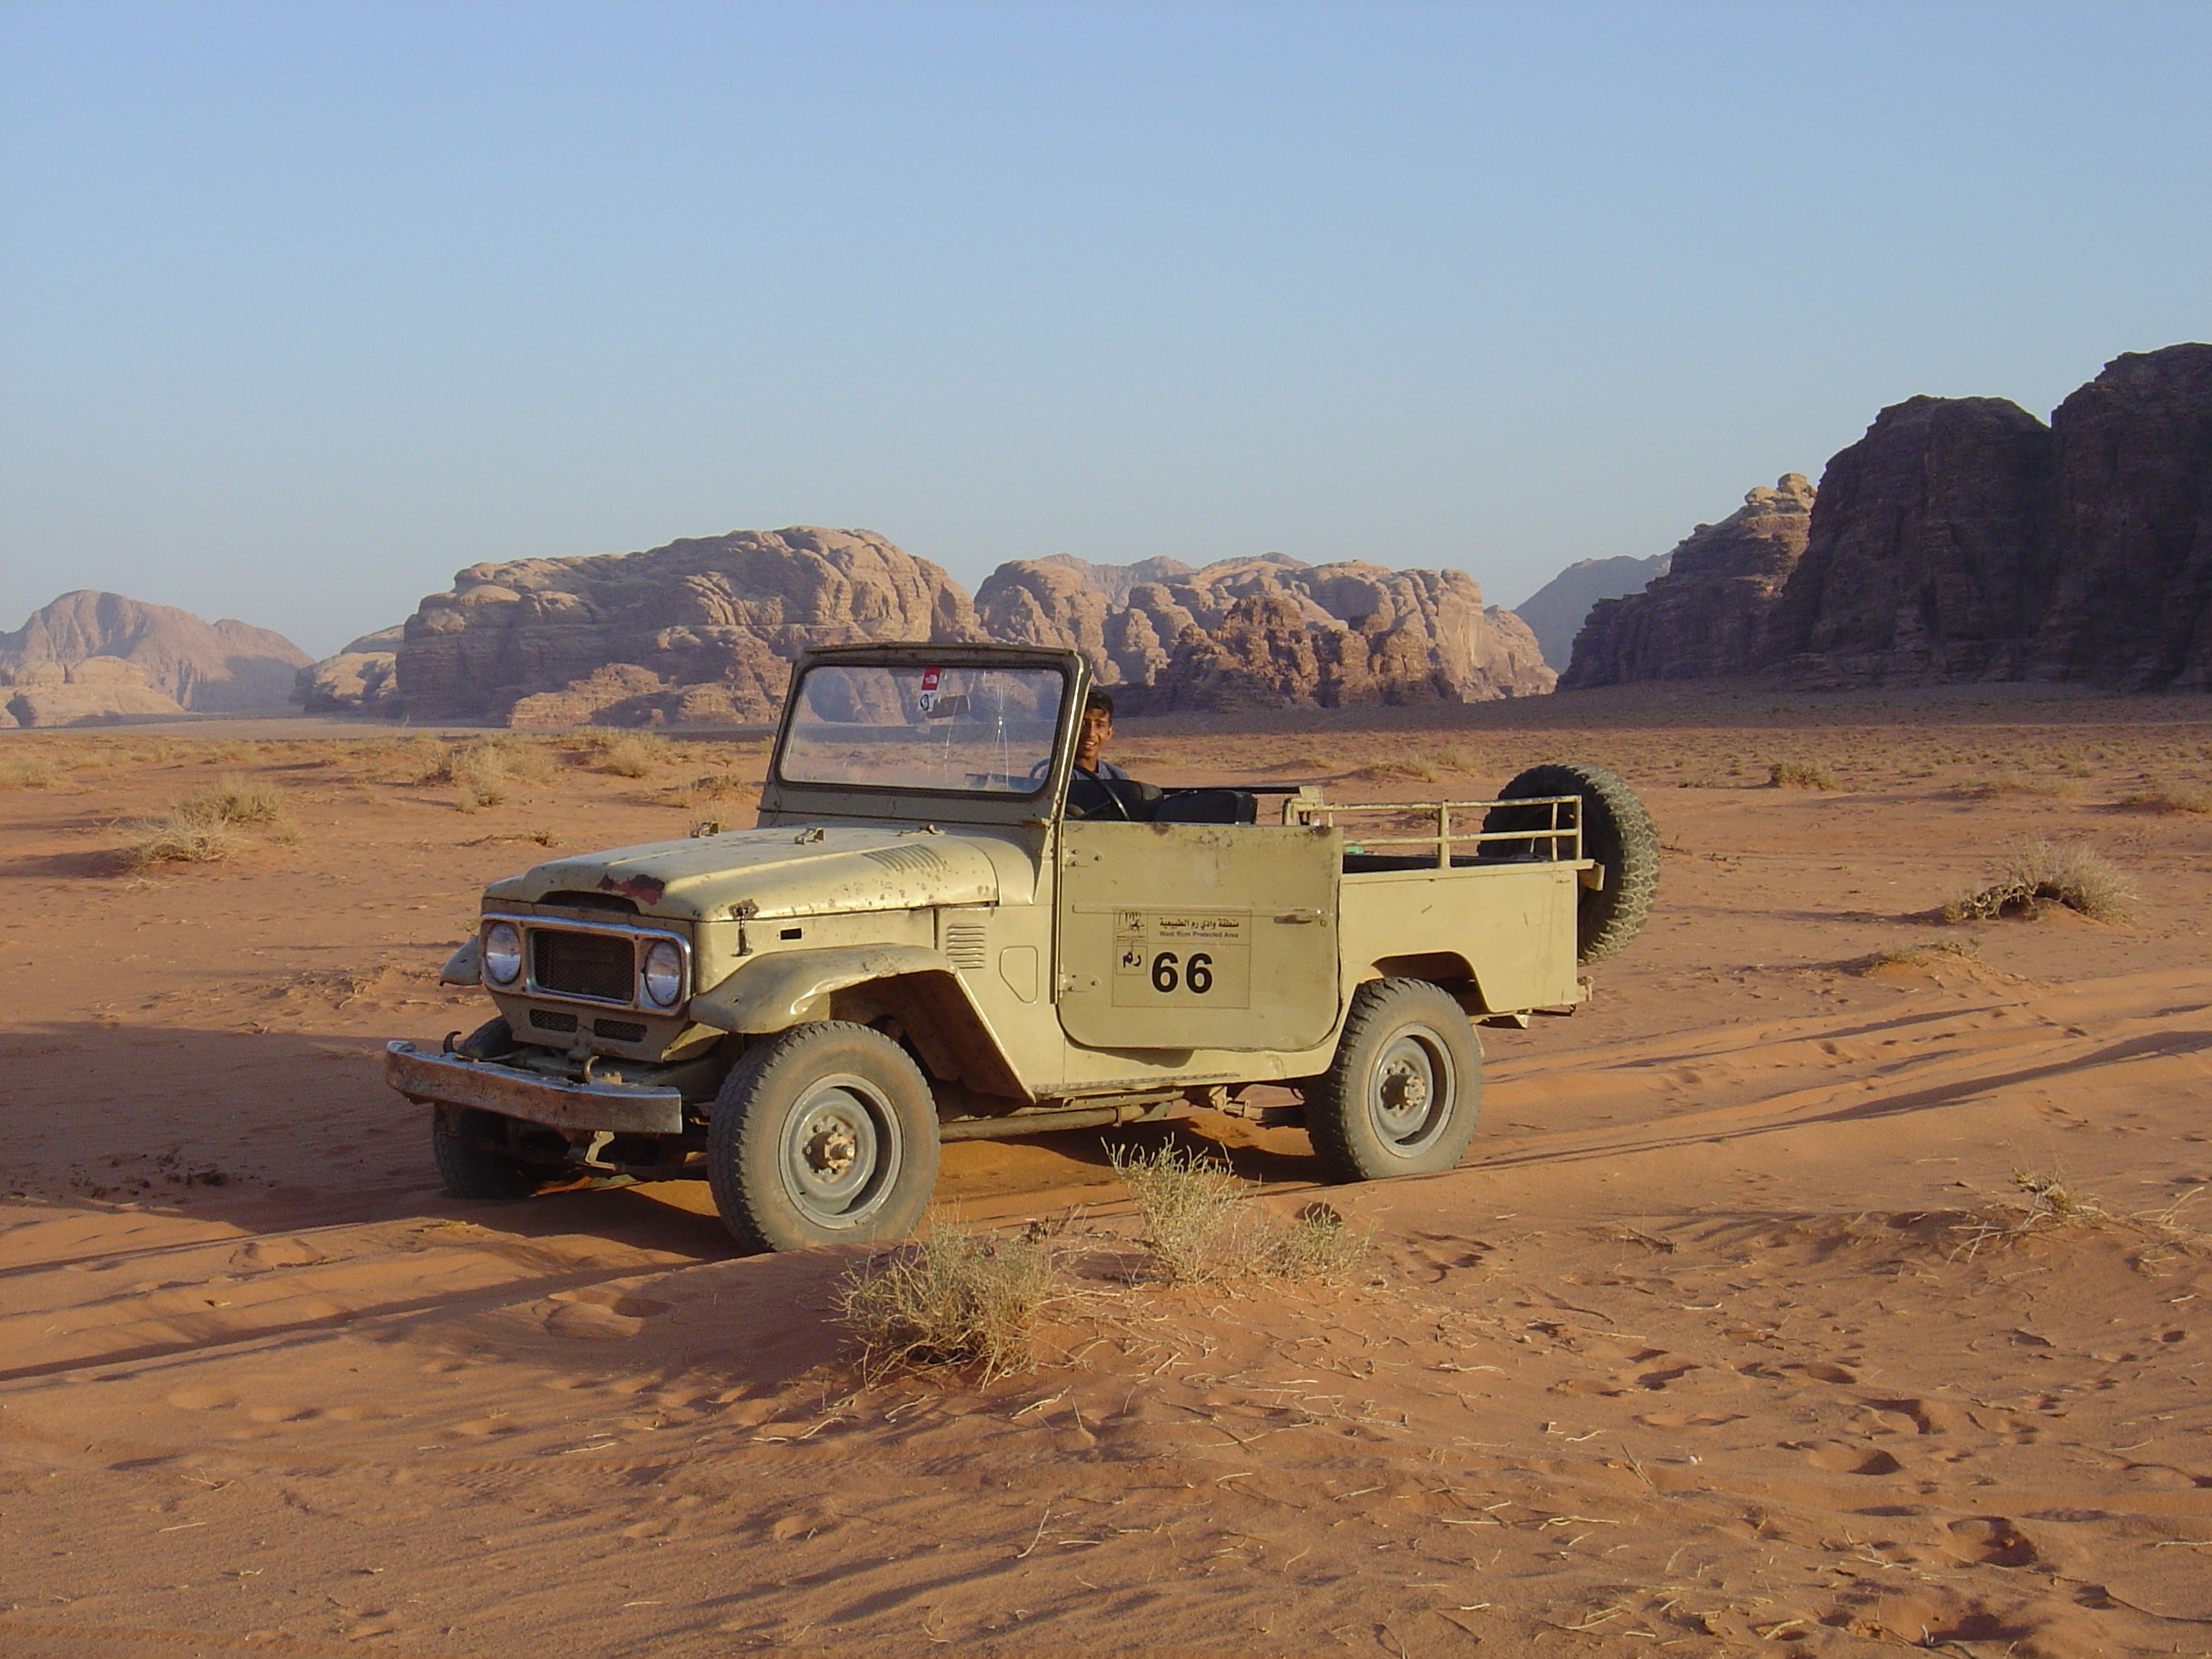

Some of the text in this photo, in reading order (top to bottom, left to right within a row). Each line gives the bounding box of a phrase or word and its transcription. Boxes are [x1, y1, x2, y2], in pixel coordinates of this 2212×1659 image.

[1159, 917, 1190, 928] الطبيعية
[1201, 919, 1216, 930] وادي
[1218, 917, 1239, 928] منطقة
[1151, 952, 1213, 994] 66
